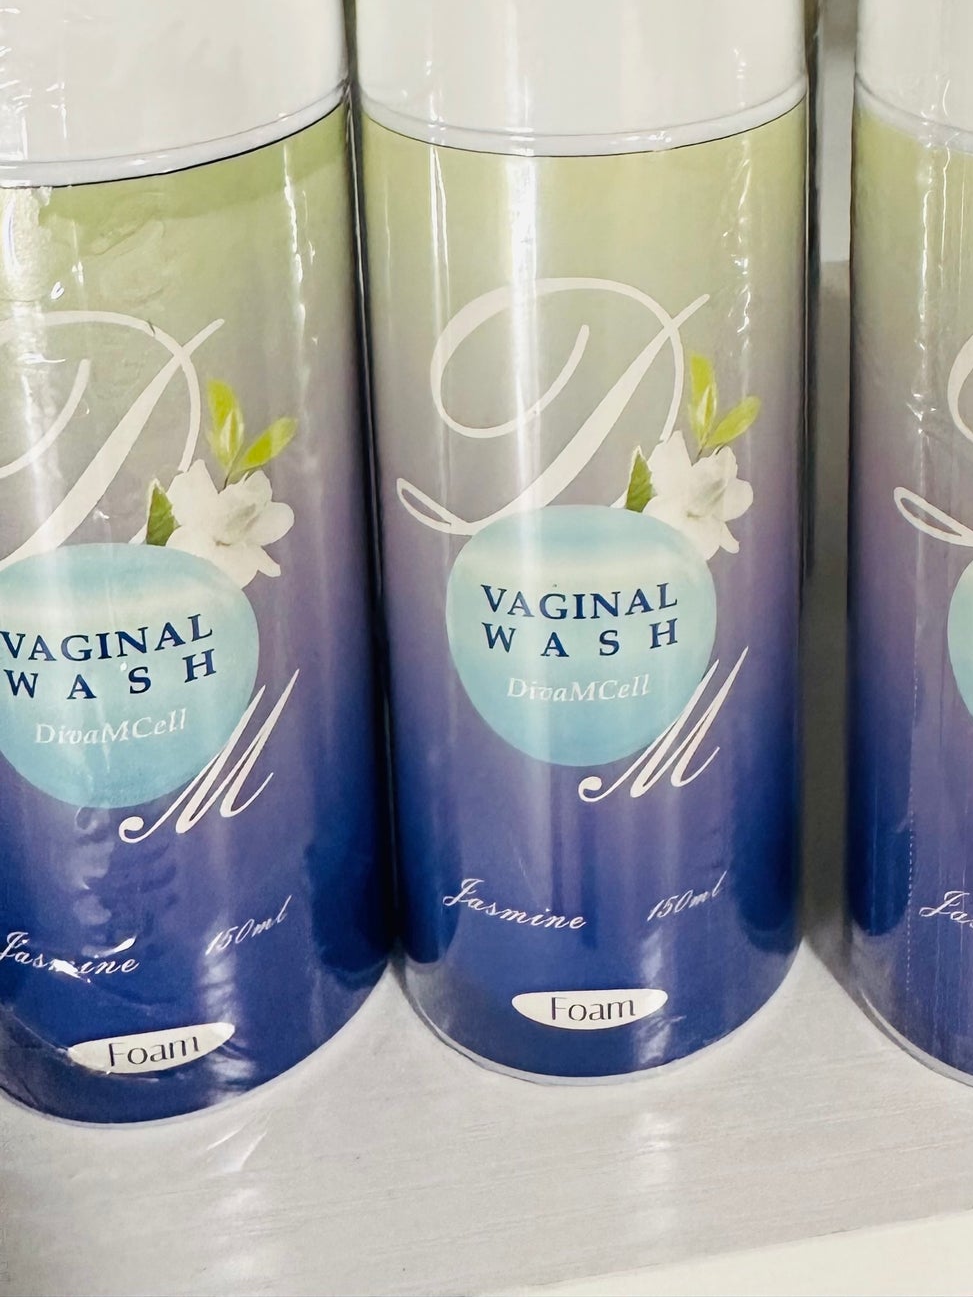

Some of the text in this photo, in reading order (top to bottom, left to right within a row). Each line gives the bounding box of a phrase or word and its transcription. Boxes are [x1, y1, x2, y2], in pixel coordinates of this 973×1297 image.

[481, 583, 678, 620] VAGINAL
[0, 614, 213, 662] VAGINAL
[481, 618, 678, 657] WASH
[3, 648, 217, 700] WASH
[507, 674, 650, 702] DivaMCell
[34, 708, 187, 745] DivaMCell
[578, 646, 749, 802] M
[118, 668, 300, 843] M
[443, 878, 587, 929] Jasmine
[647, 870, 728, 921] 150ml
[205, 895, 292, 955] 150ml
[551, 997, 636, 1022] Foam
[108, 1036, 200, 1067] Foam
